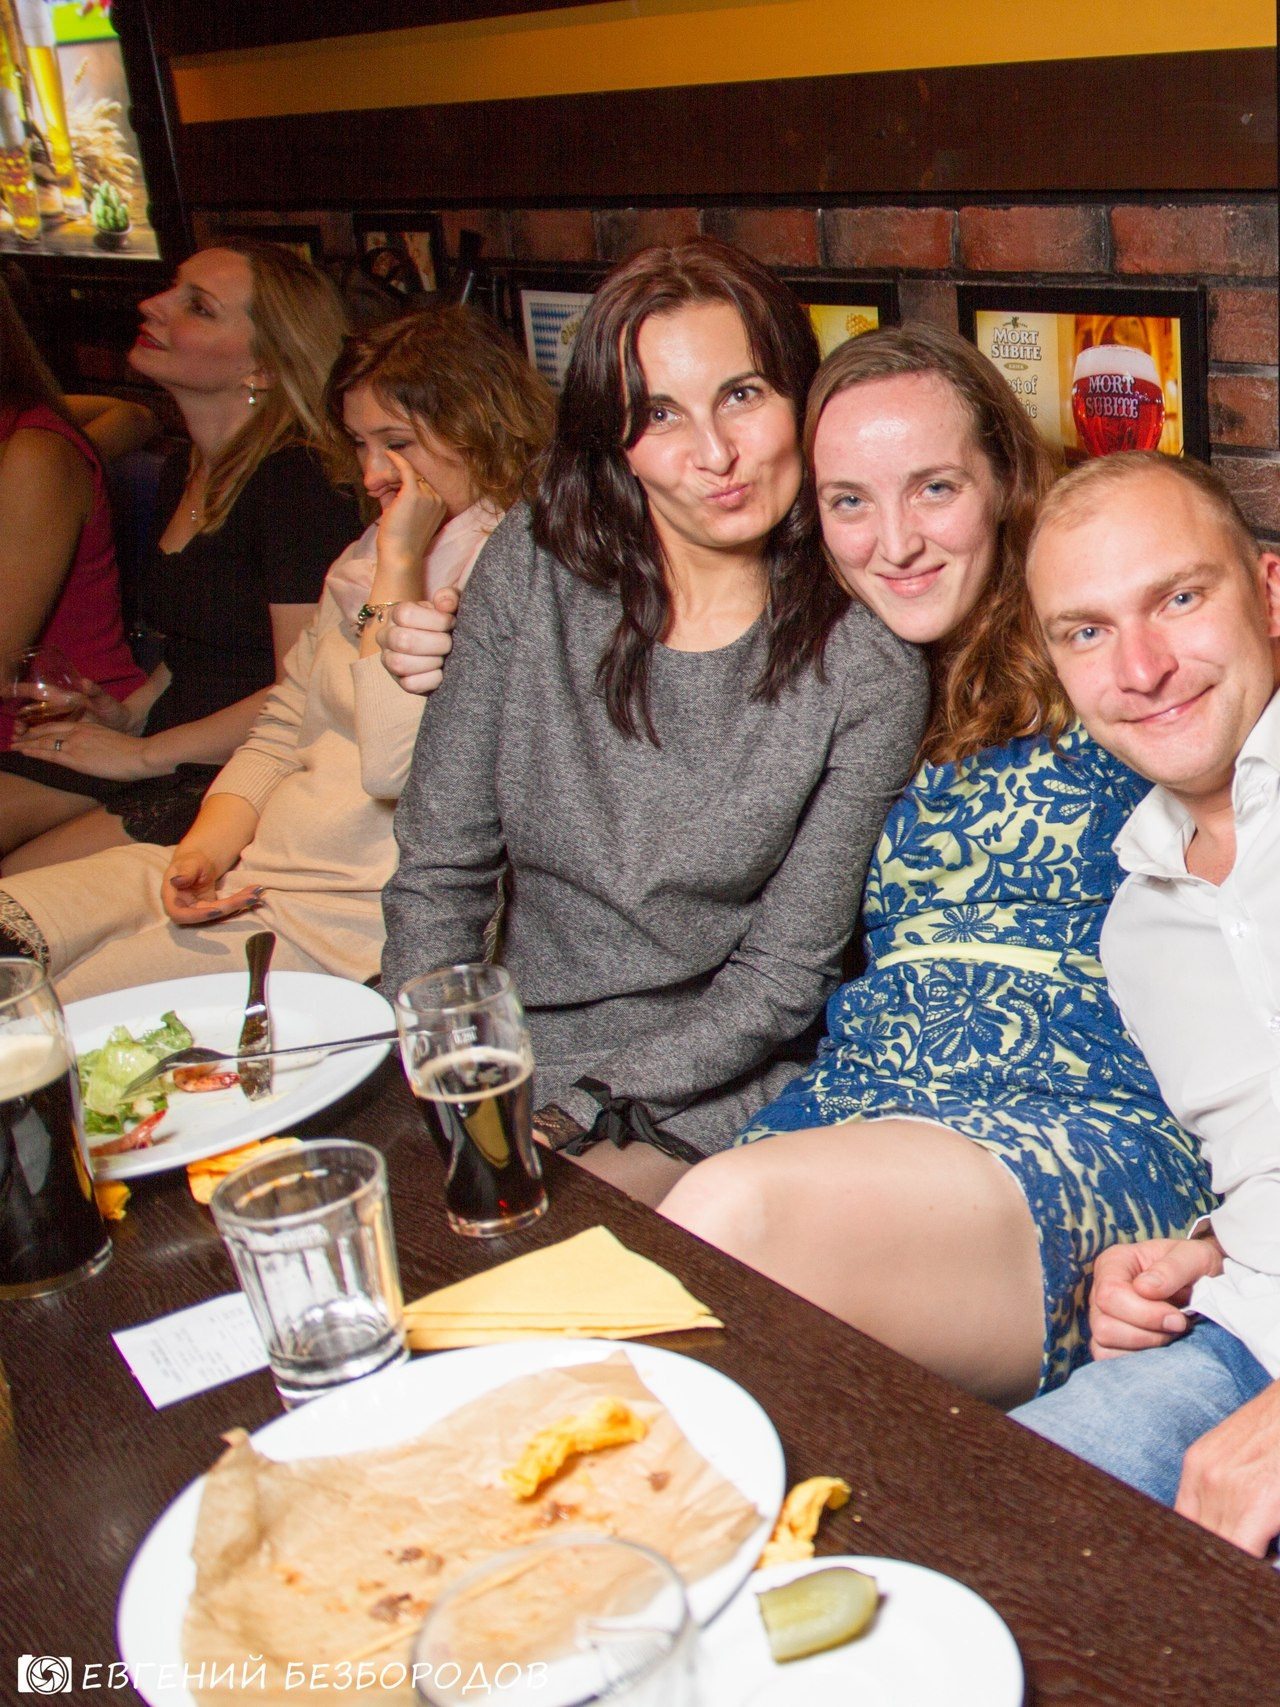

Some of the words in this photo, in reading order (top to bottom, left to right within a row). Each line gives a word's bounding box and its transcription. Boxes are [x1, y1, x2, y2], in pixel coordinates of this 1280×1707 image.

[994, 327, 1039, 345] MORT
[991, 344, 1041, 360] SUBITE
[1024, 375, 1038, 394] of
[1088, 374, 1135, 395] MORT
[1085, 396, 1139, 419] SUBITE
